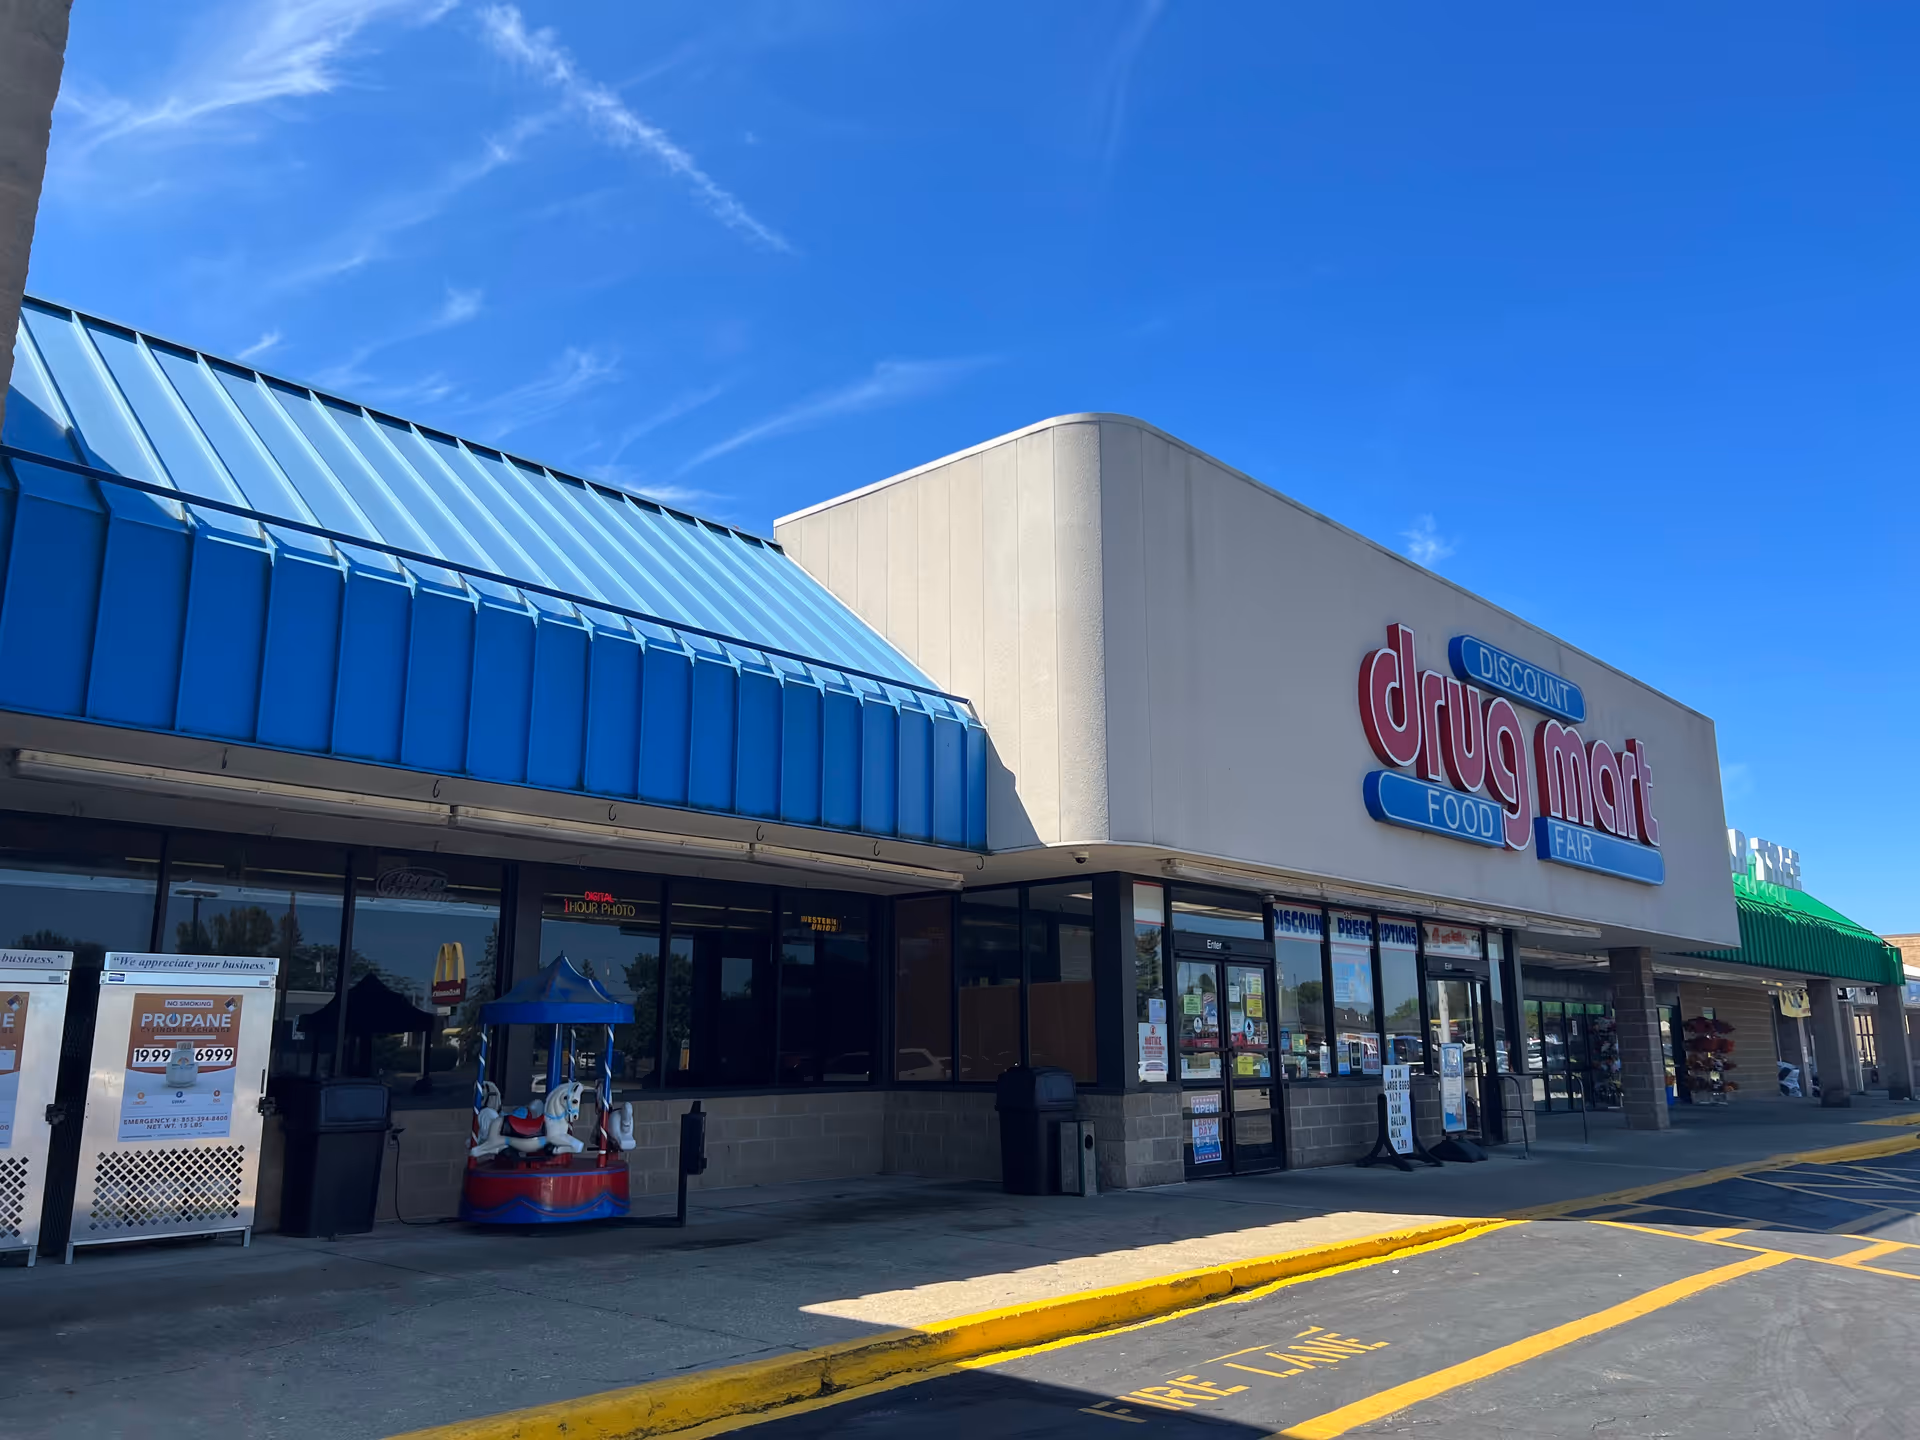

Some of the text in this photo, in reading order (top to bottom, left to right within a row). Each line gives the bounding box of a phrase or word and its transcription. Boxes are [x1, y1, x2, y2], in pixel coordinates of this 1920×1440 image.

[1480, 647, 1570, 712] DISCOUNT
[1359, 622, 1660, 851] drug mart
[1427, 788, 1494, 837] FOOD
[1554, 826, 1595, 864] FAIR
[1749, 837, 1803, 891] TREE
[584, 891, 615, 903] DIGITAL
[569, 901, 598, 914] HOUR
[601, 904, 636, 917] PHOTO
[800, 915, 837, 925] WESTERN
[1206, 940, 1222, 950] Enter
[138, 957, 193, 971] appreciate
[194, 961, 220, 971] your
[140, 1013, 232, 1028] PROPANE
[134, 1049, 171, 1062] 19.99
[1384, 1080, 1410, 1091] LARGE EGGS
[1194, 1103, 1215, 1114] OPEN
[123, 1117, 170, 1126] EMERGENCY
[1390, 1115, 1407, 1127] GALLON
[1198, 1126, 1213, 1136] DAY
[1390, 1128, 1402, 1139] MILK
[1078, 1332, 1391, 1423] FIRE LANE
